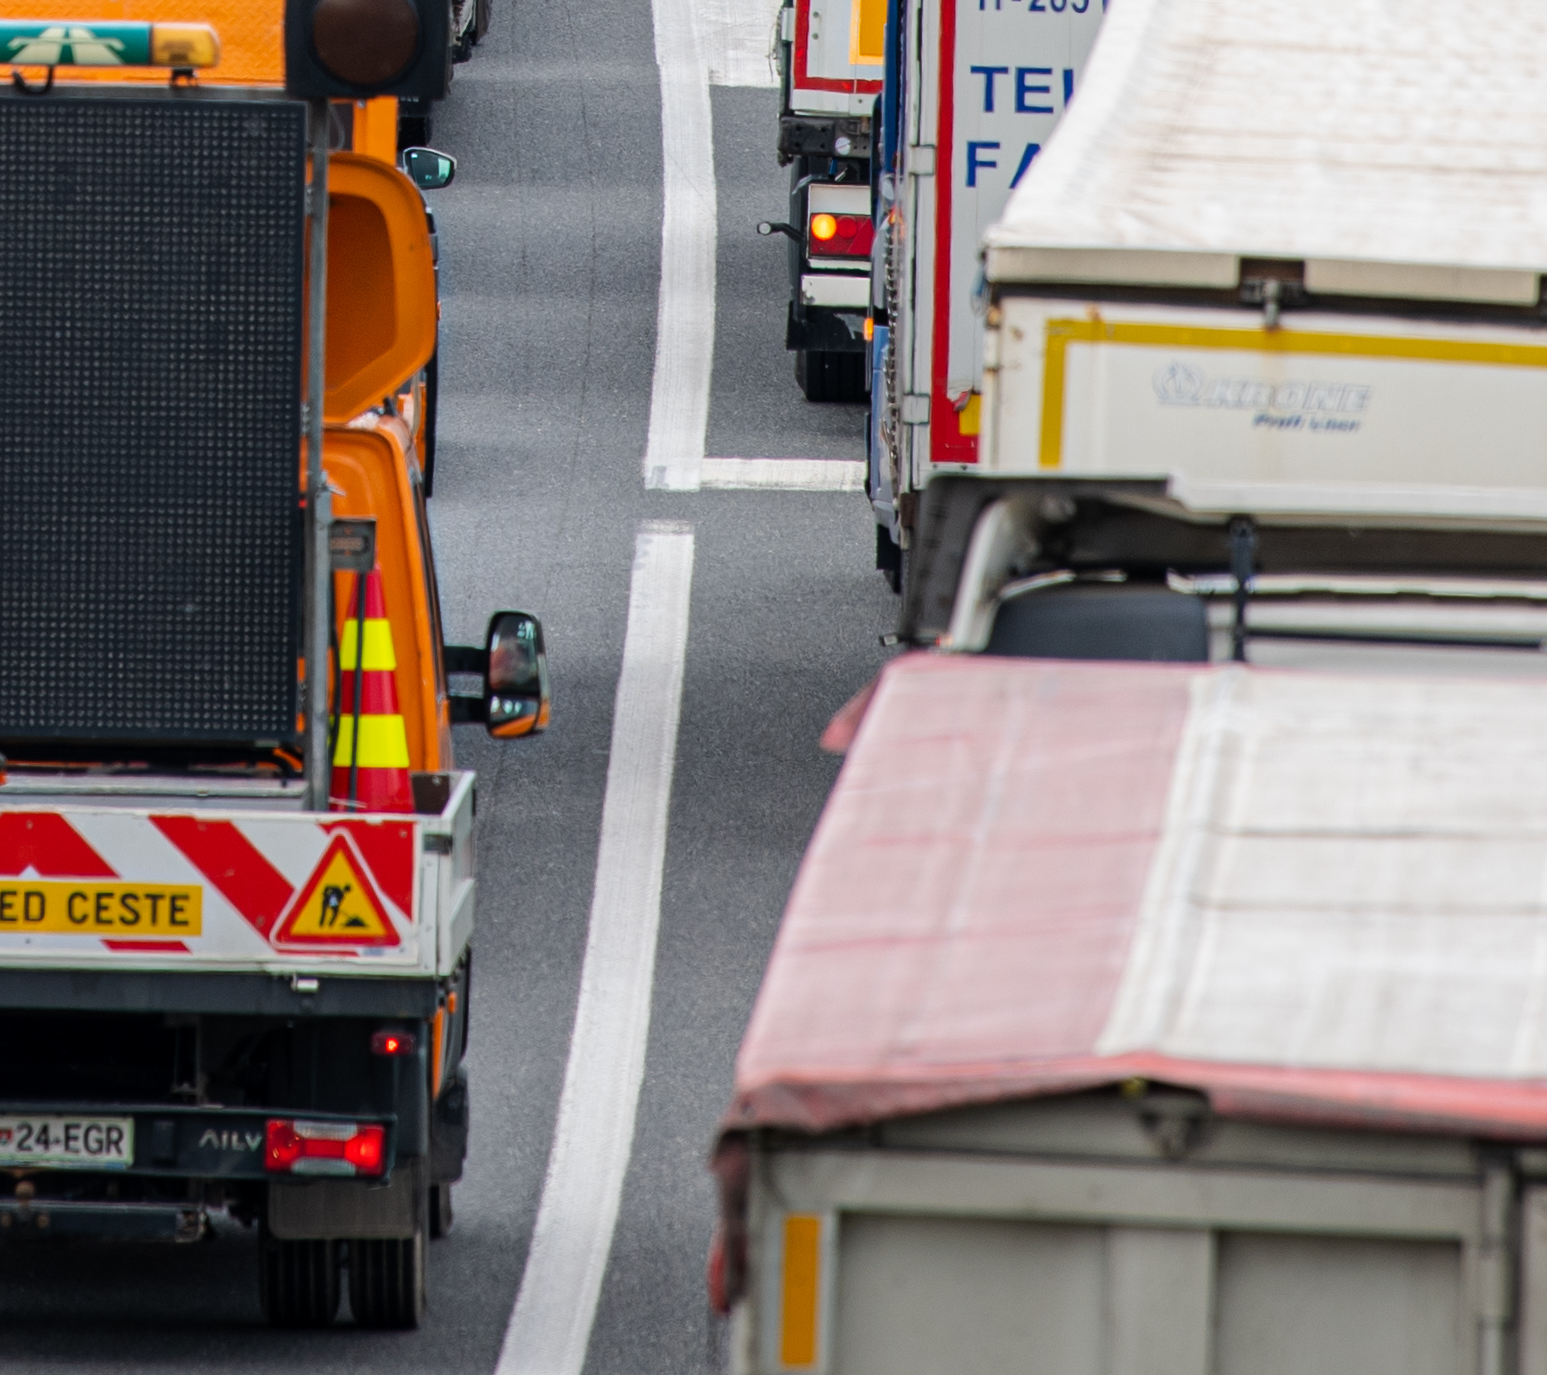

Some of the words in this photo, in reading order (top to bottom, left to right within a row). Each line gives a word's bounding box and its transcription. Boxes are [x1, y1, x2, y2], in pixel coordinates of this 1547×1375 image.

[1206, 379, 1372, 413] KRONE
[66, 891, 190, 927] CESTE
[16, 1121, 124, 1156] 24-EGR
